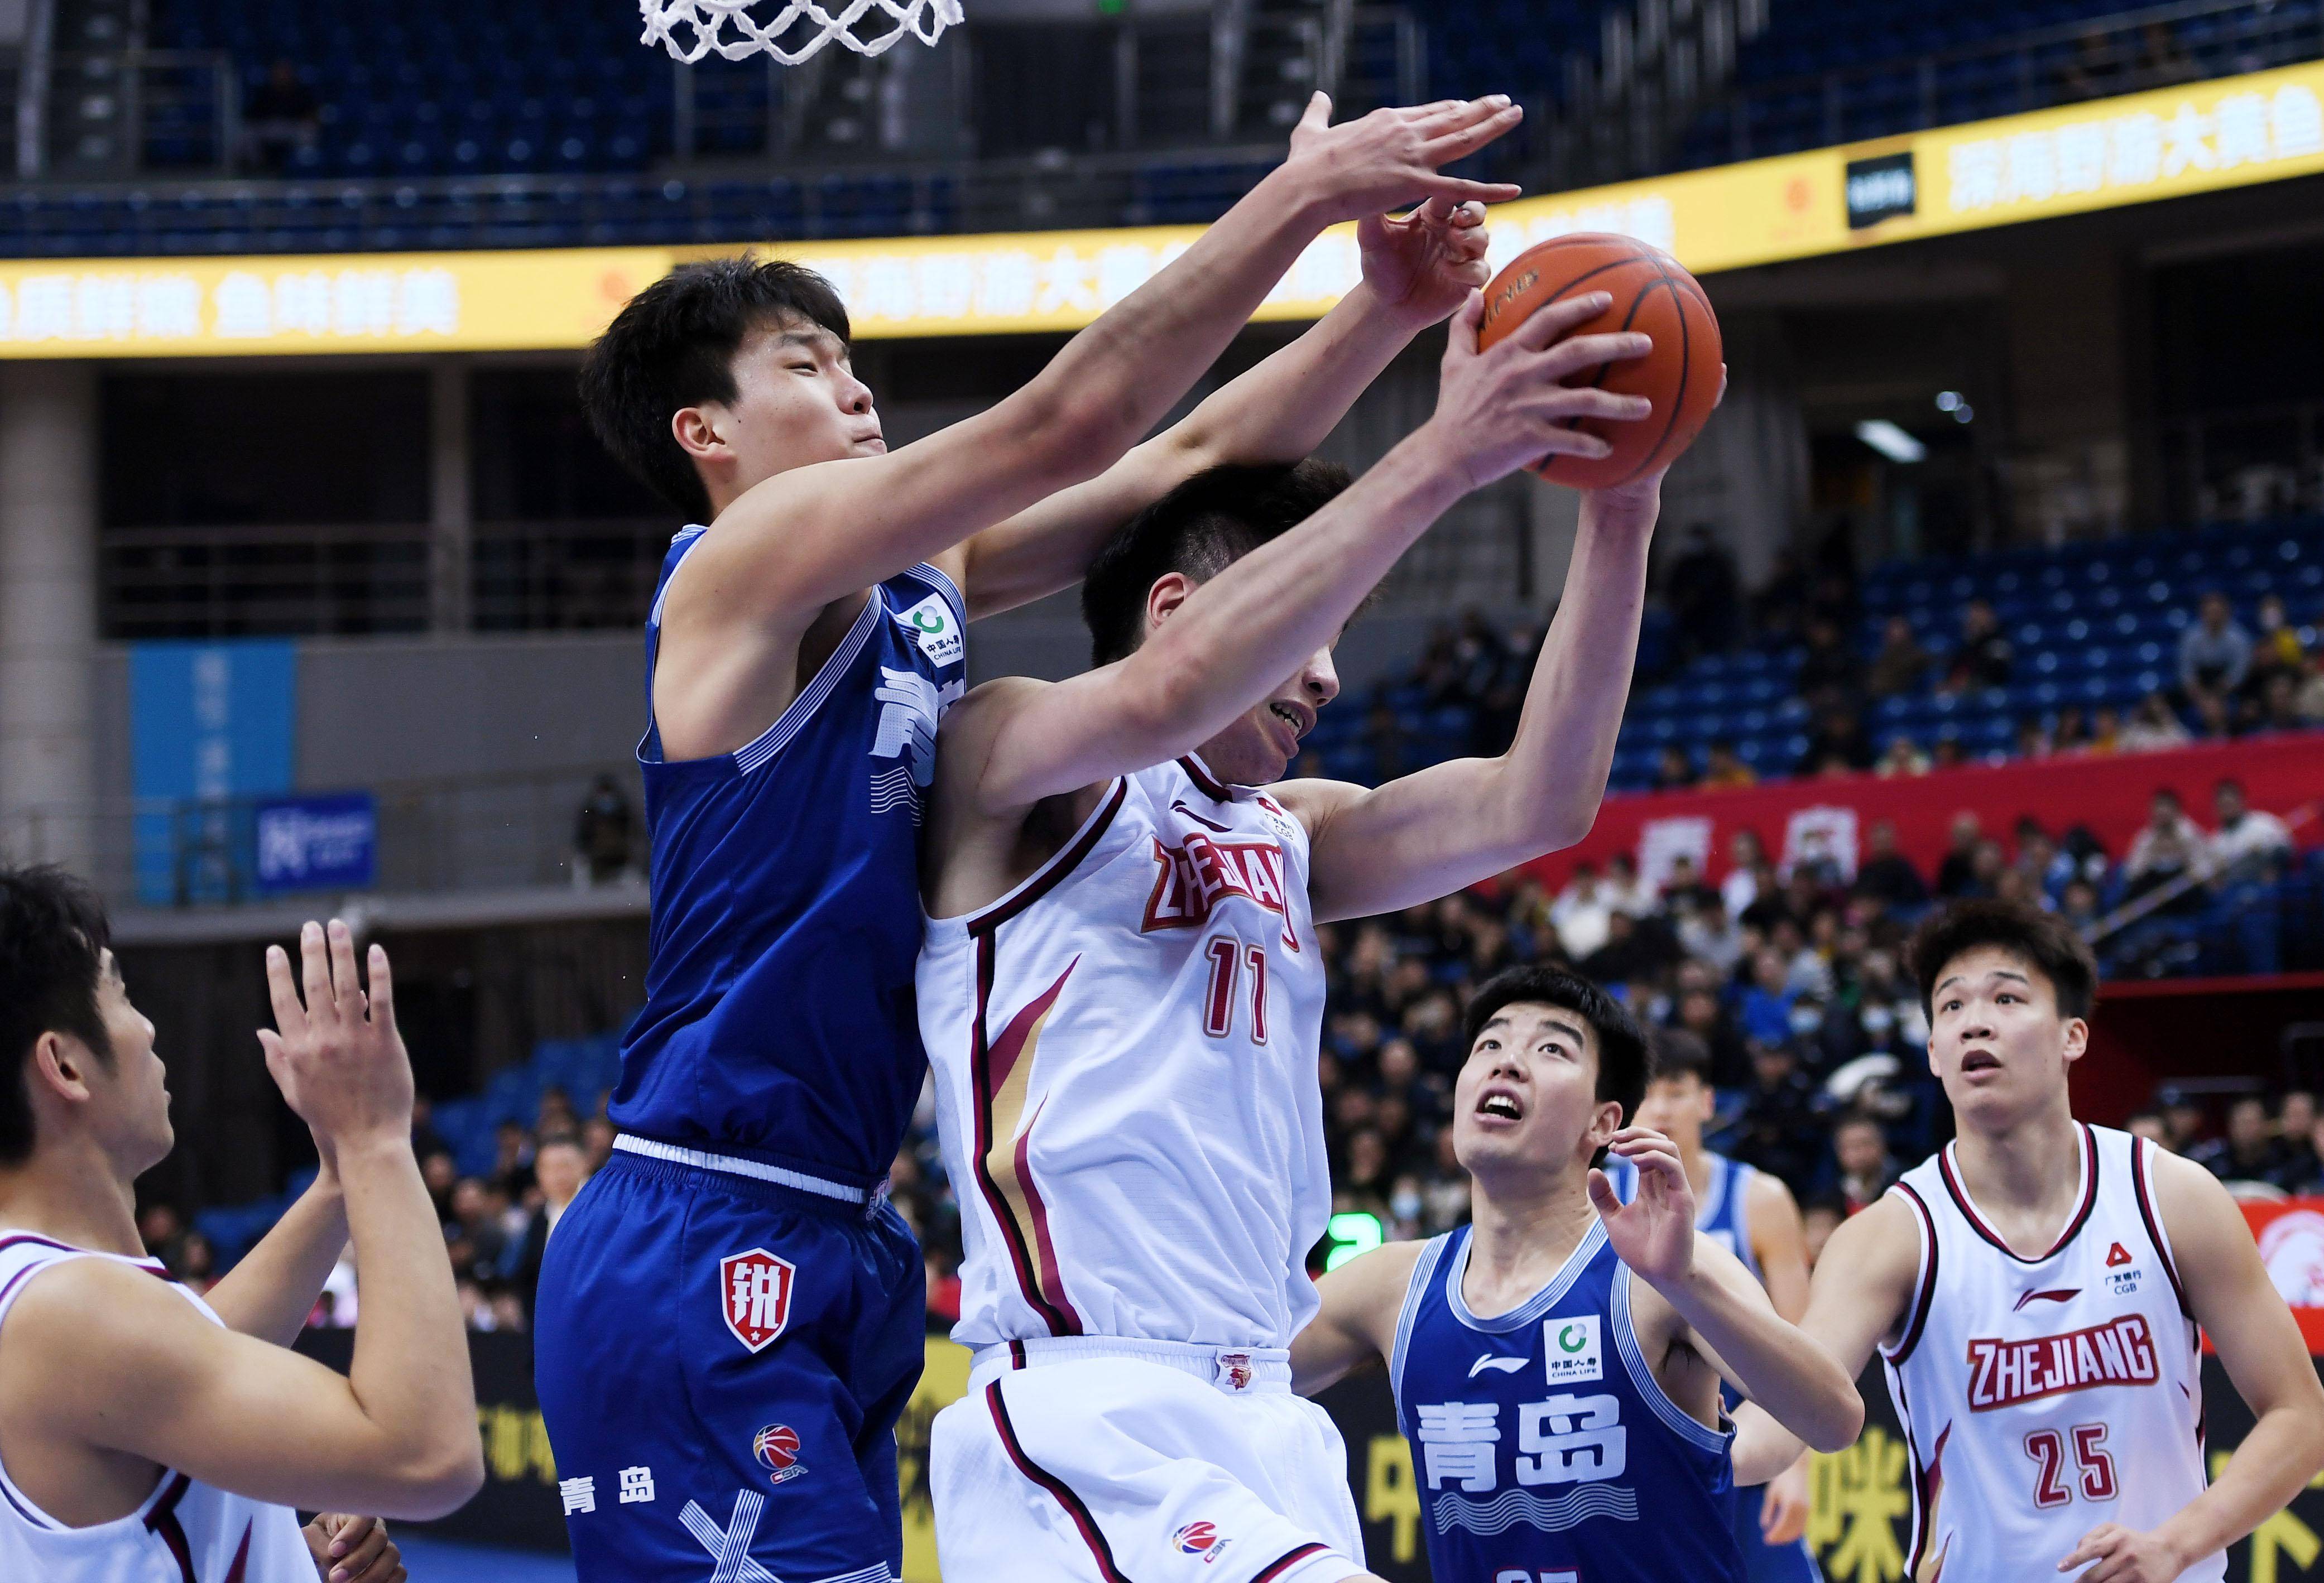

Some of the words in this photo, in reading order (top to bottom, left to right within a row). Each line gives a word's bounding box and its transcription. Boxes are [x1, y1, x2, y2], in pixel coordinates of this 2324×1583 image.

[934, 649, 953, 660] CHINA
[867, 666, 965, 787] 青
[1275, 825, 1293, 840] CGB
[1203, 935, 1269, 1047] 11
[2114, 1283, 2137, 1295] CGB
[1552, 1357, 1596, 1370] 中国人寿
[1972, 1319, 2154, 1407] ZHEJIANG
[1415, 1393, 1626, 1492] 青岛
[2024, 1422, 2119, 1509] 25
[558, 1466, 655, 1516] 青岛
[770, 1465, 809, 1485] CBA
